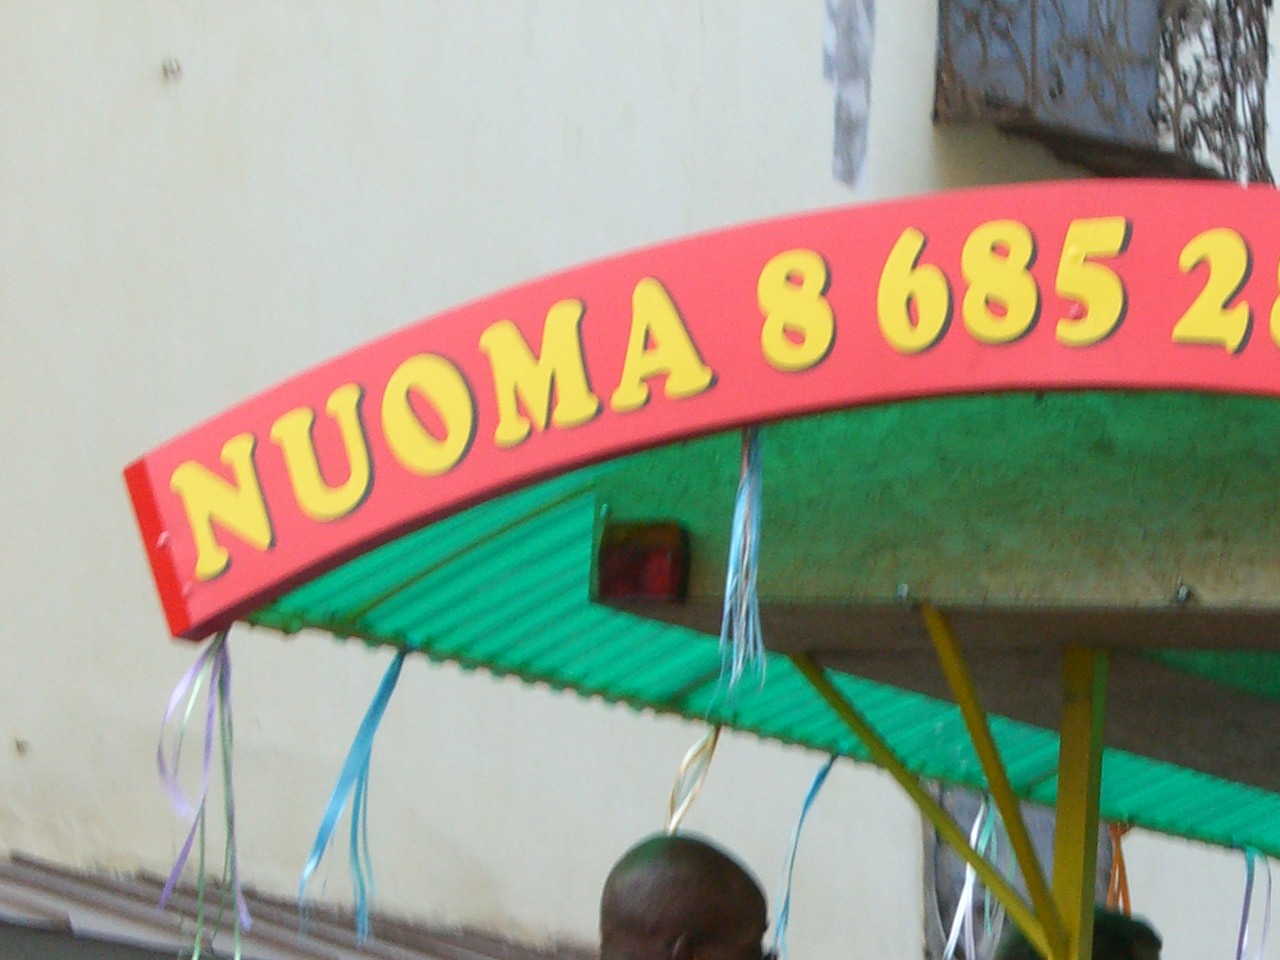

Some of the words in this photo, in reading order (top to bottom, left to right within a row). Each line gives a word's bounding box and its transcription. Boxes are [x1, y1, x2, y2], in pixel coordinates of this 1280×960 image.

[169, 276, 715, 581] NUOMA
[756, 247, 836, 372] 8
[876, 215, 1131, 353] 685
